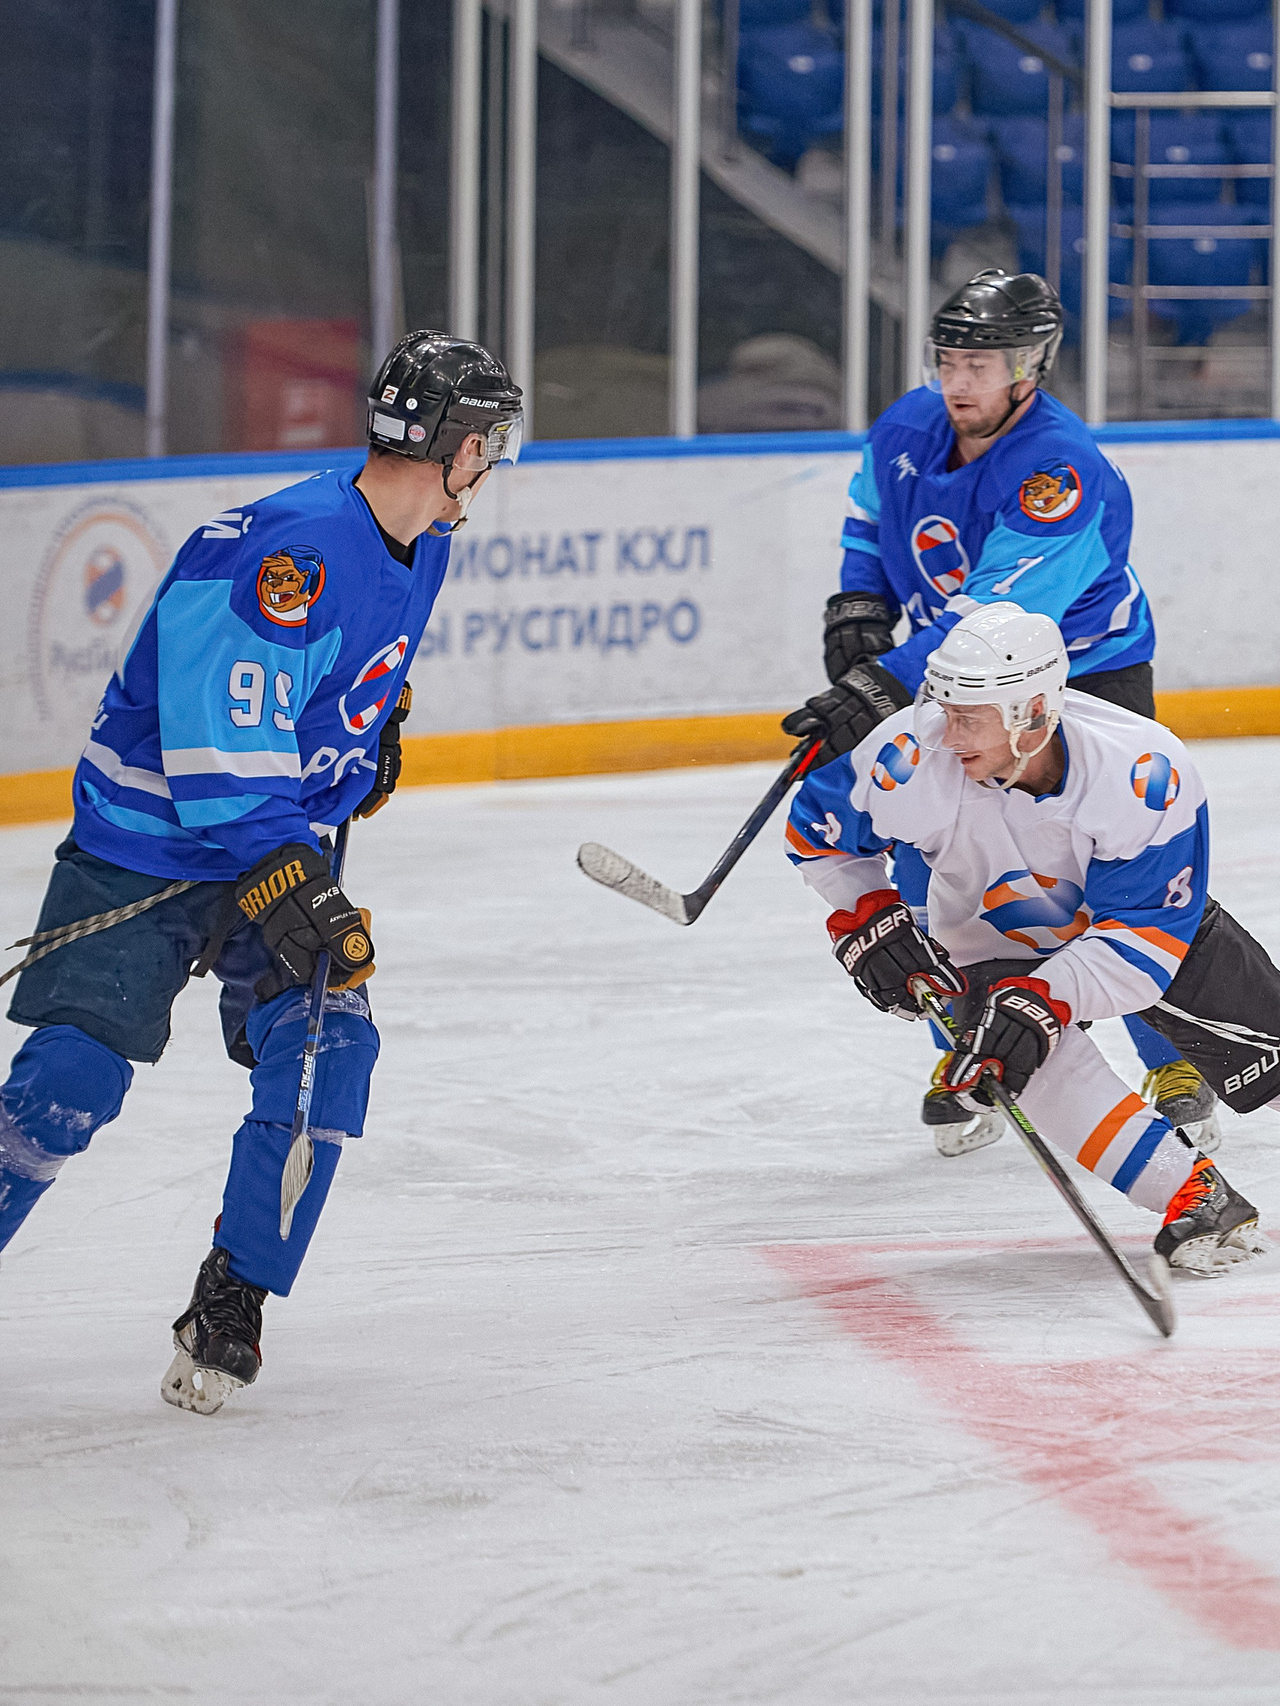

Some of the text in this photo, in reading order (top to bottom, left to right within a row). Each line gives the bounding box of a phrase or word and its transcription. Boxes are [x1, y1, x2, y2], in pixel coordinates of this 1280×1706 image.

[459, 396, 500, 409] BAUER
[614, 526, 711, 573] КХЛ
[463, 598, 701, 657] РУСГИДРО
[1163, 866, 1193, 908] 8
[841, 908, 911, 971] BAUER
